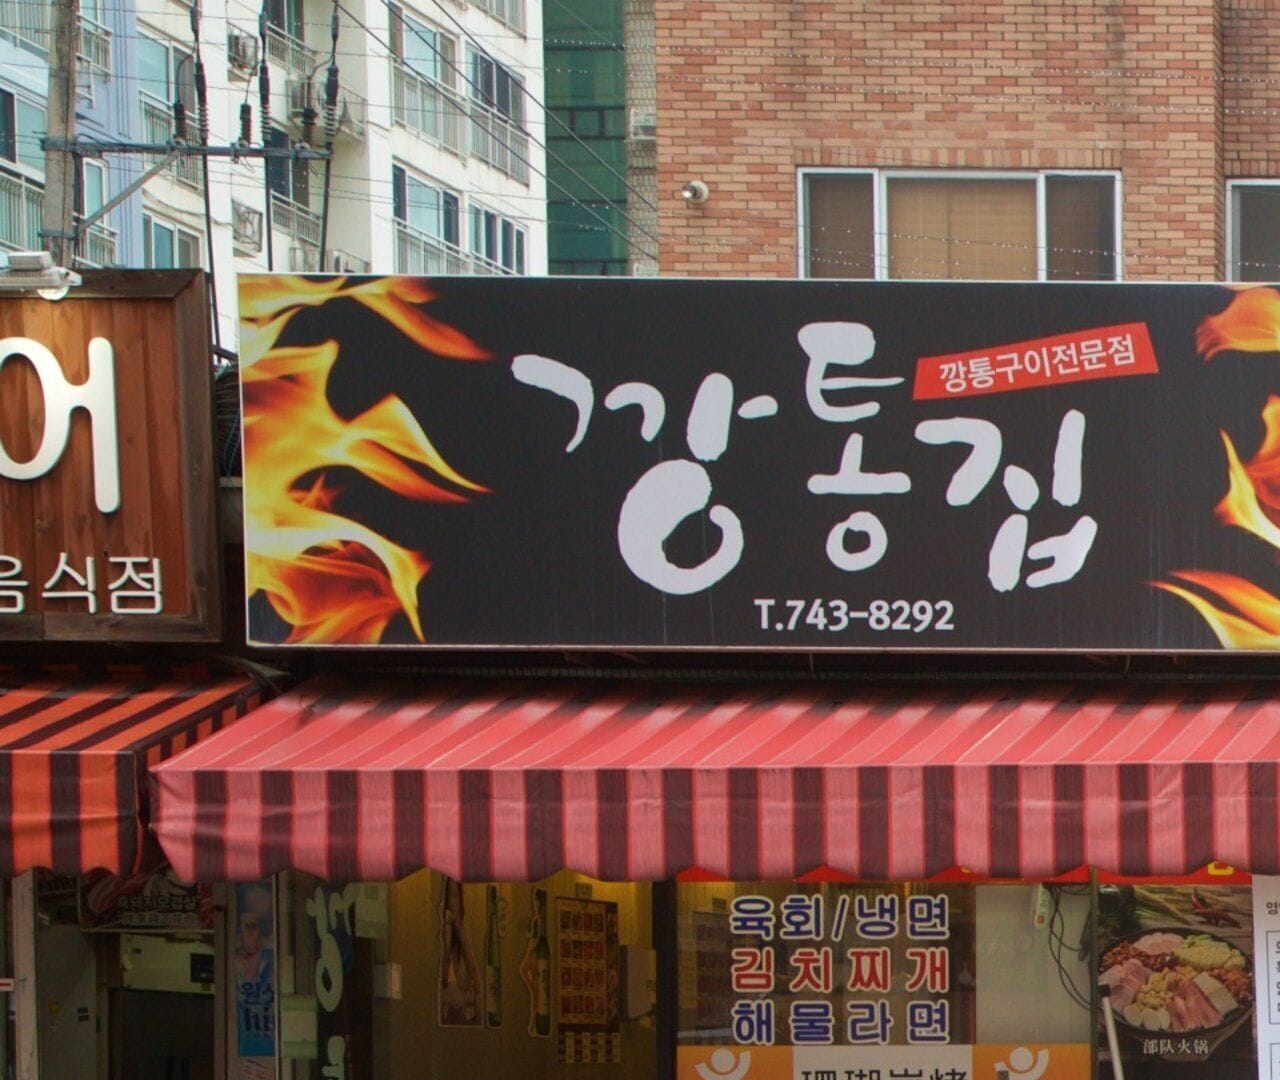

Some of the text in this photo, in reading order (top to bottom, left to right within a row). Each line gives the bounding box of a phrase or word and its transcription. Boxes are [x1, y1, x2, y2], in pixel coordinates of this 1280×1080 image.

[939, 331, 1137, 395] 깡통구이전문점
[755, 598, 955, 633] T.743-8292
[729, 893, 951, 942] 육회/냉면
[730, 946, 950, 993] 김치찌개
[731, 999, 951, 1046] 해물라면
